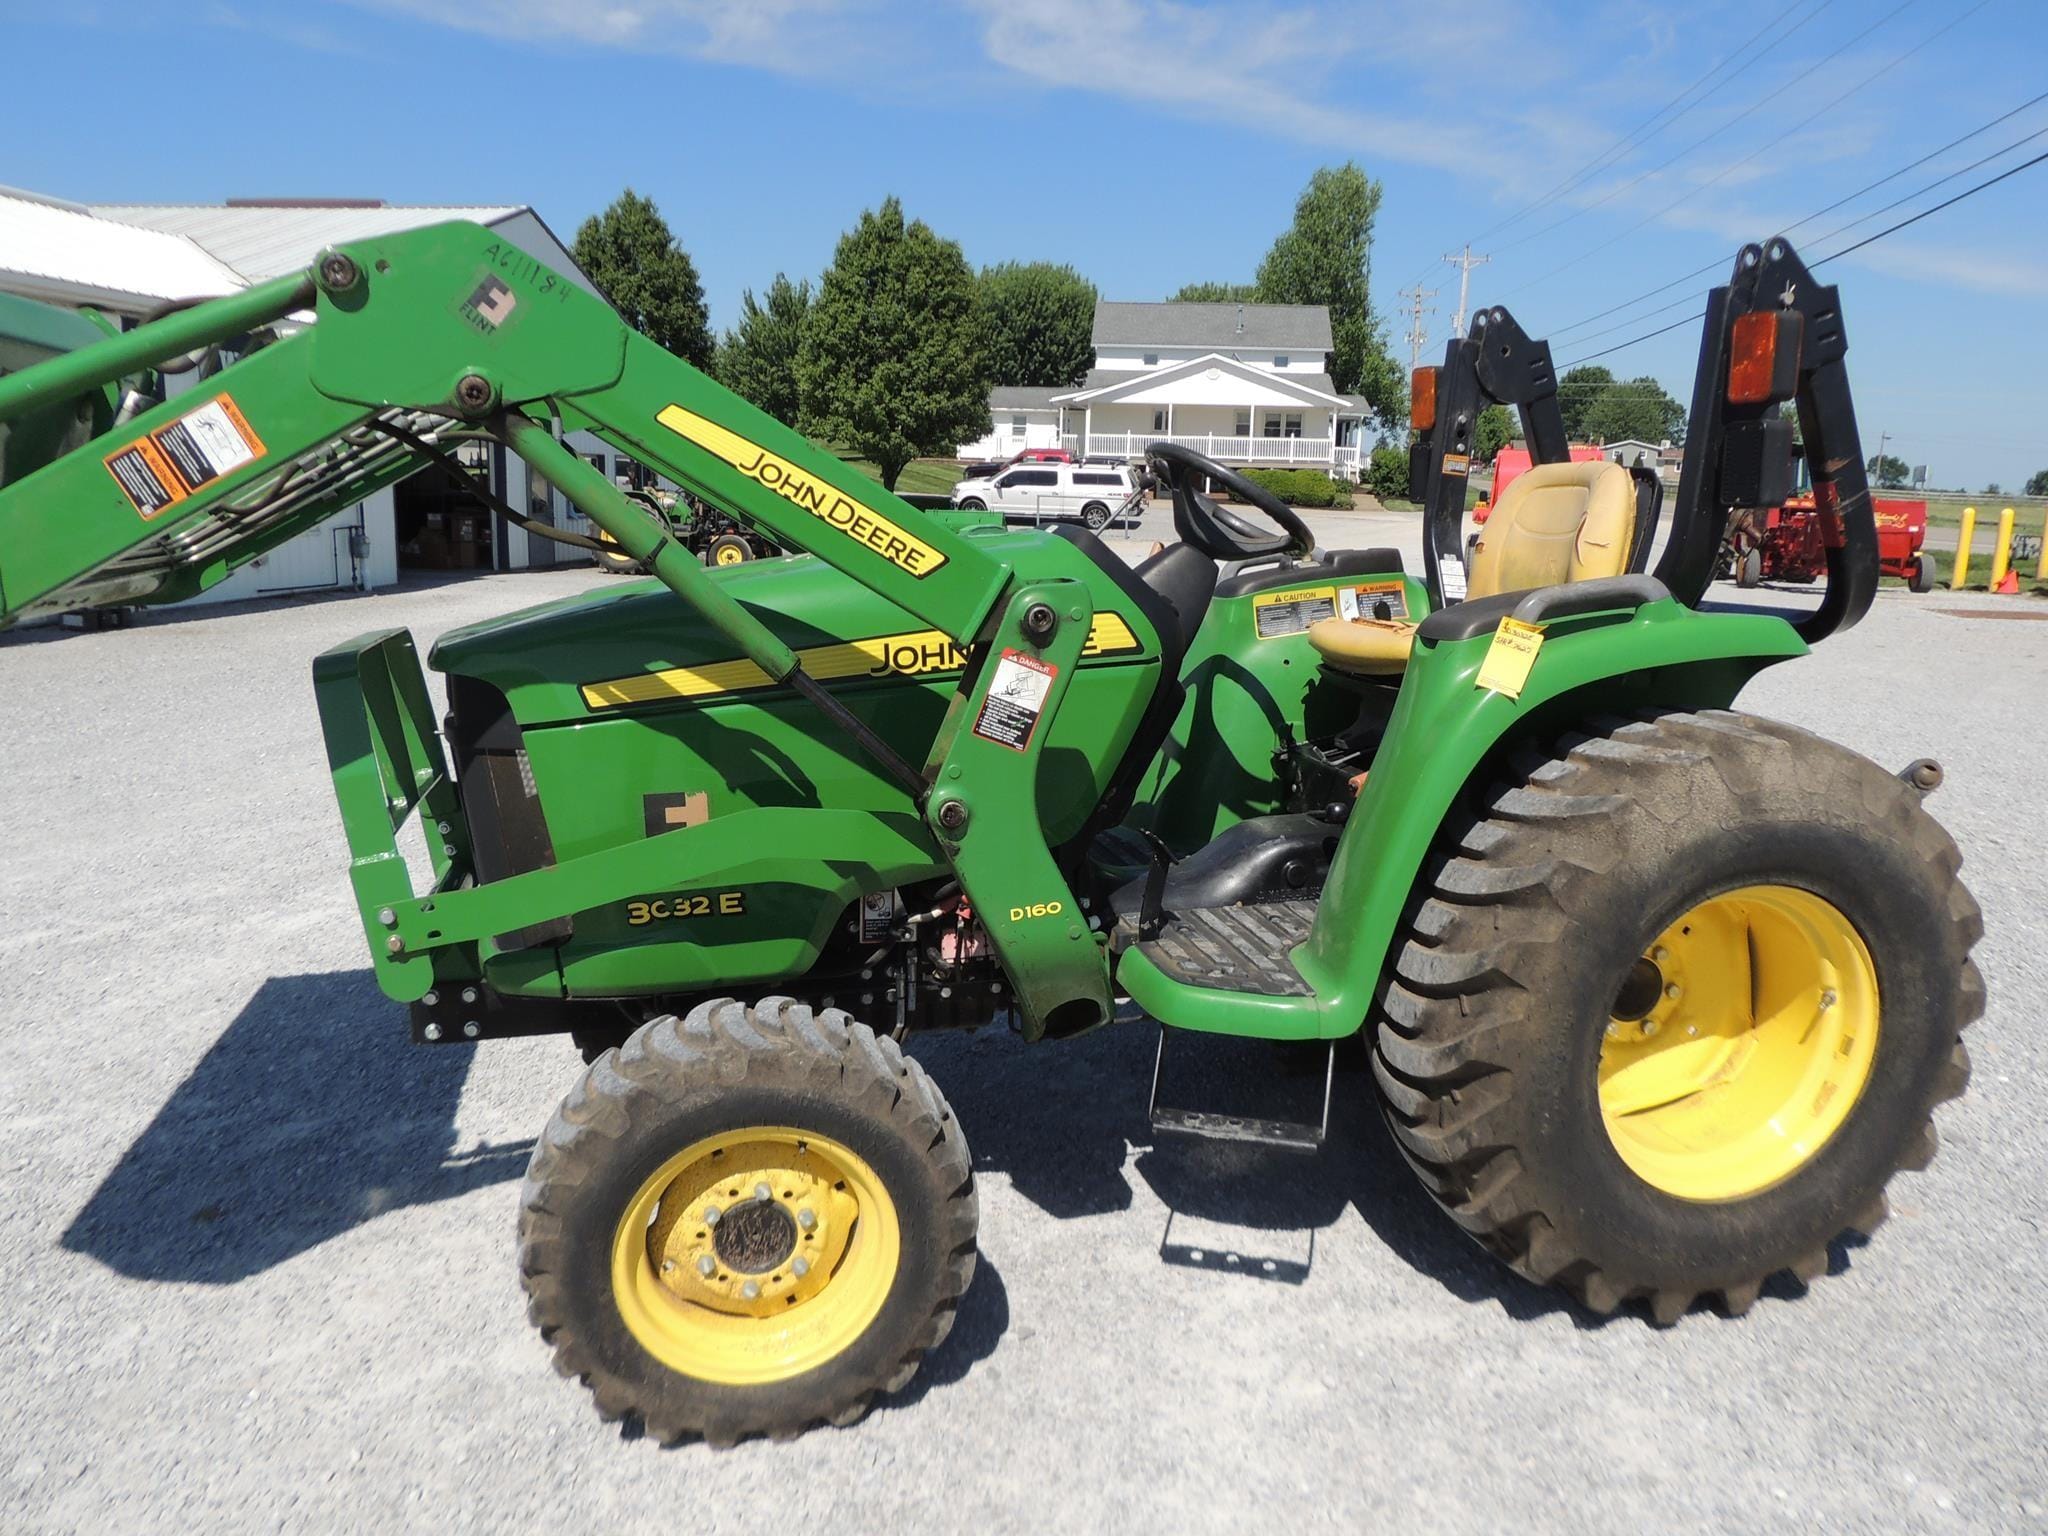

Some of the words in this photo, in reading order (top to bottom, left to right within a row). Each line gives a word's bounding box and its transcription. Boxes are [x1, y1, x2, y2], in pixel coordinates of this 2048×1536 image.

[459, 301, 497, 336] FLINT
[738, 452, 827, 511] JOHN
[827, 497, 927, 572] DEERE
[1283, 591, 1317, 602] CAUTION
[1368, 583, 1398, 591] WARNING
[1019, 656, 1050, 674] DANGER
[1009, 901, 1062, 922] D160
